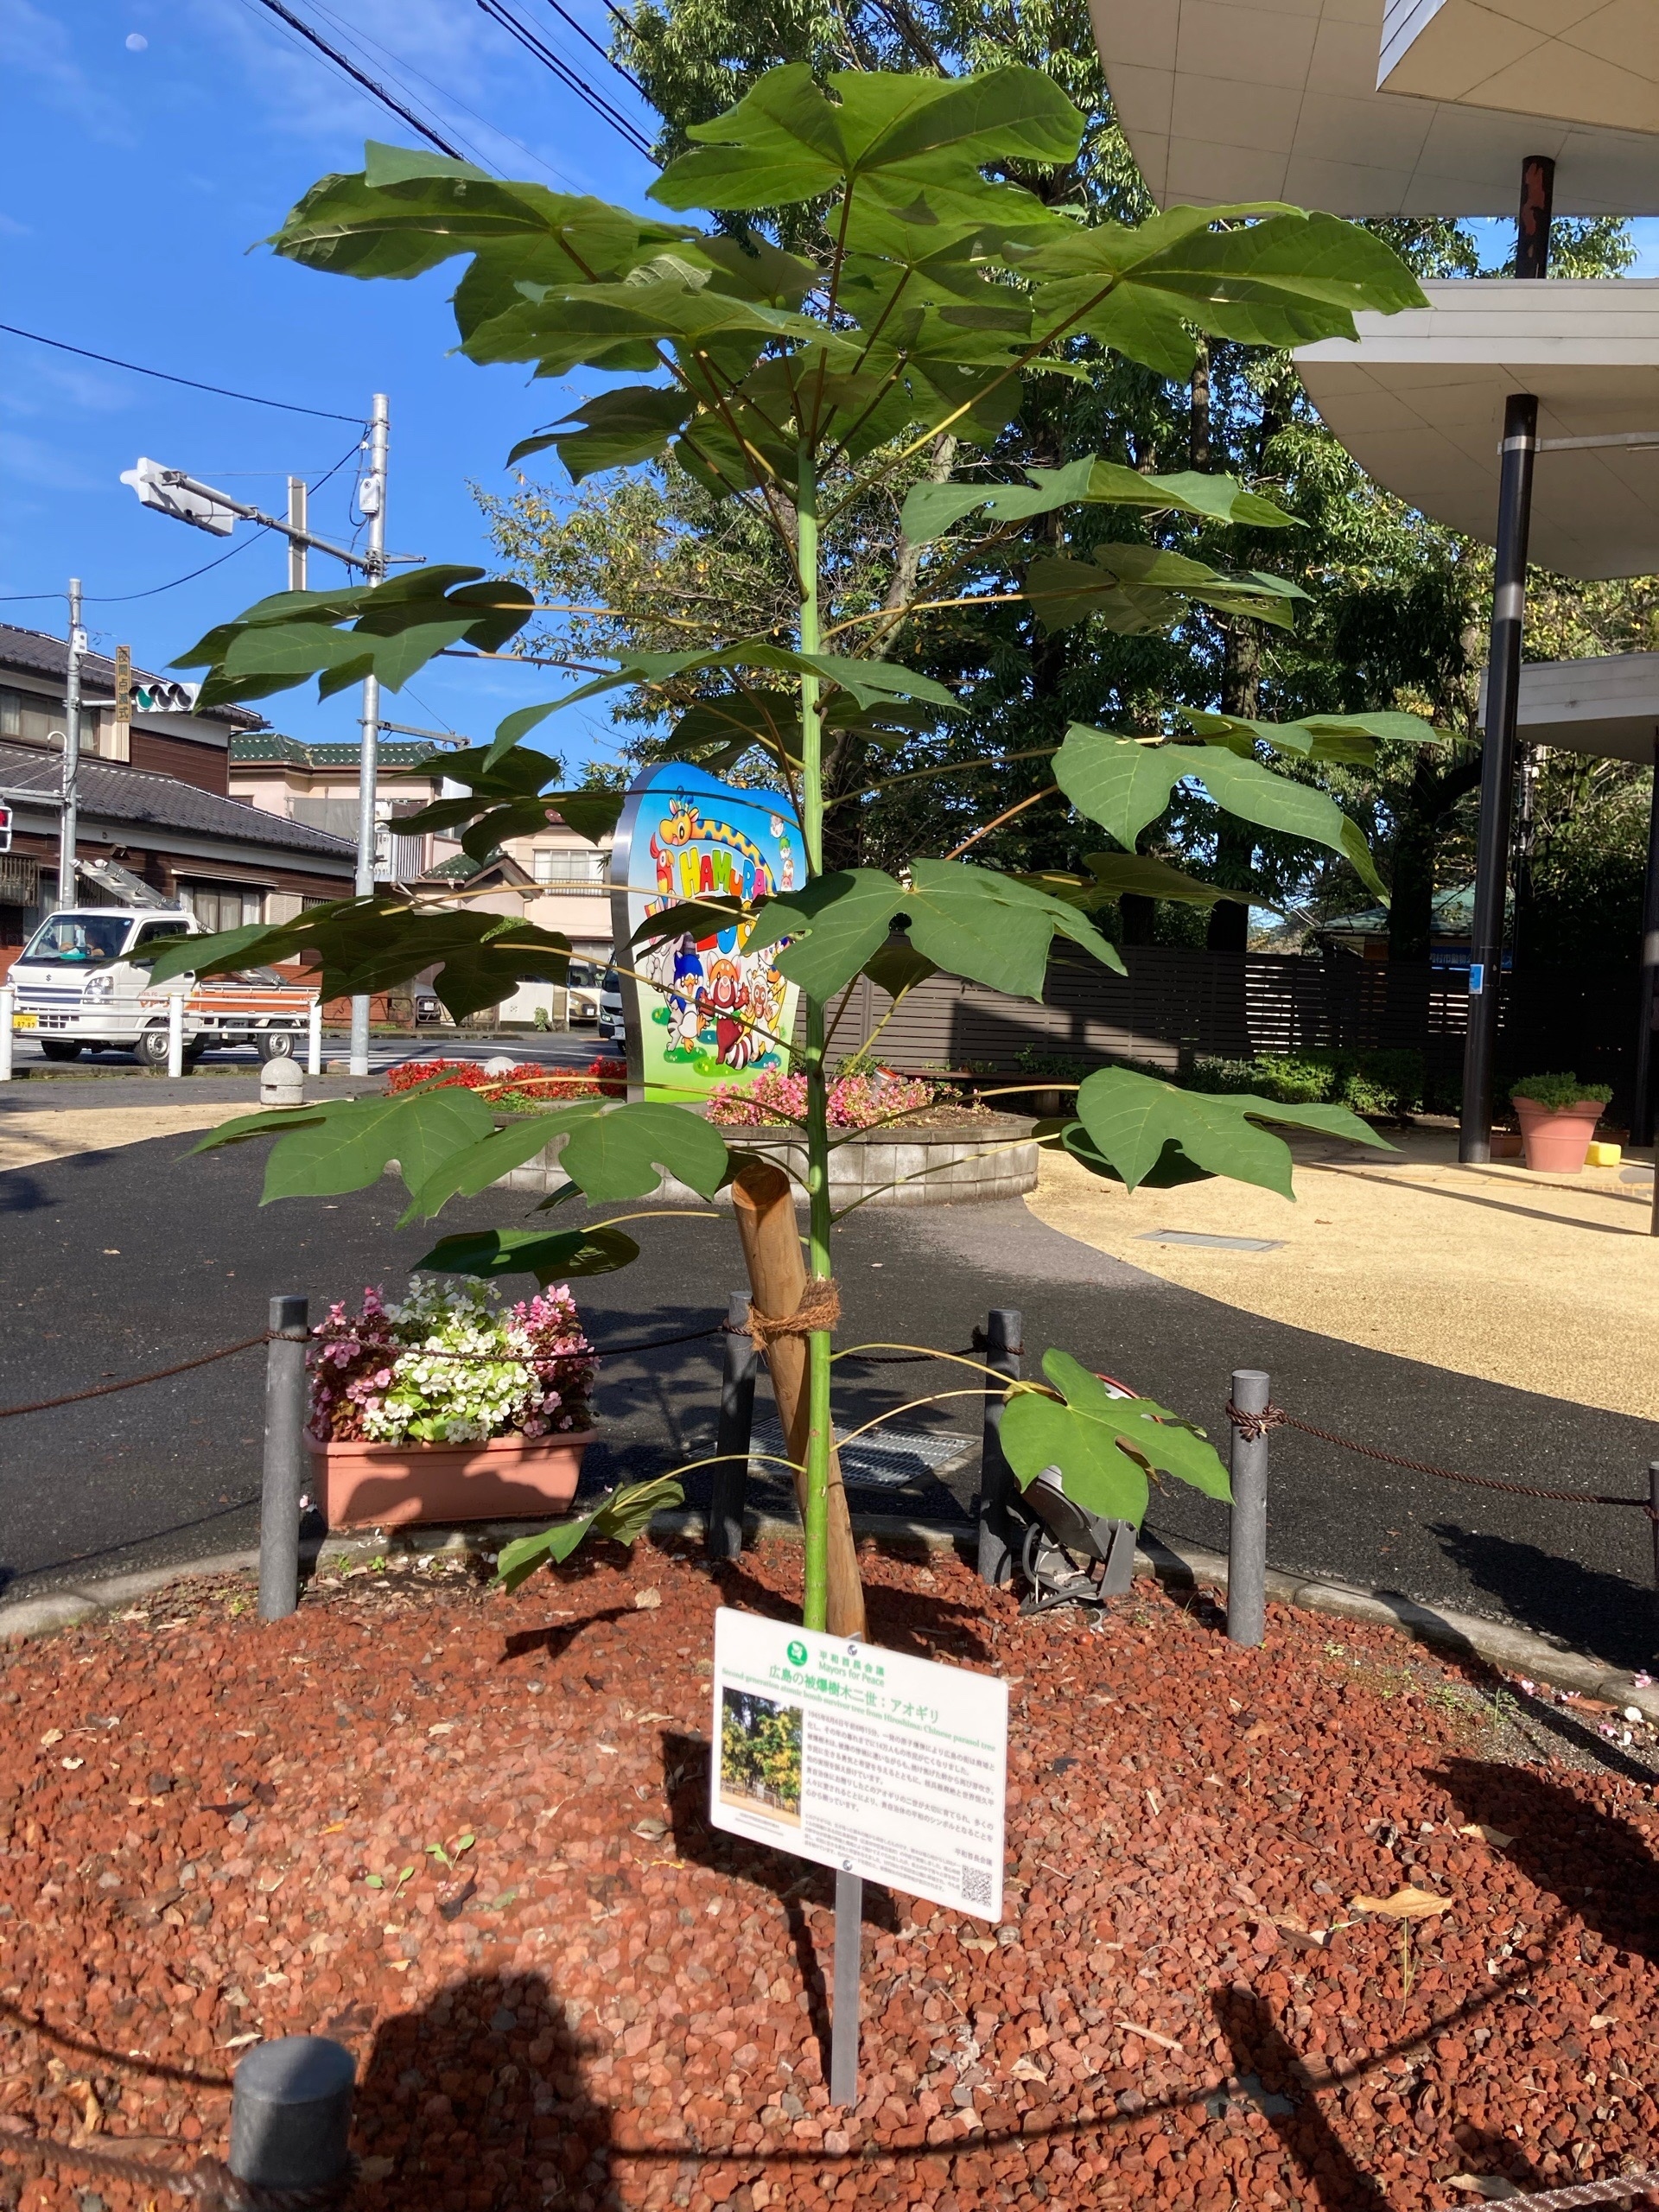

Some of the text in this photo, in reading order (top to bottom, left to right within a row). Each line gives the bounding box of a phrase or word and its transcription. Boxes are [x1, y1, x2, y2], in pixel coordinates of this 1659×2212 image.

[118, 649, 129, 719] 夜間点滅式
[678, 847, 766, 901] HAMURA
[818, 1649, 885, 1677] 平和首長会議
[818, 1661, 885, 1688] Mayors for Peace
[851, 1703, 864, 1714] tree
[866, 1707, 882, 1719] from
[924, 1724, 951, 1739] Chinese
[953, 1732, 979, 1749] parasol
[981, 1741, 995, 1752] tree
